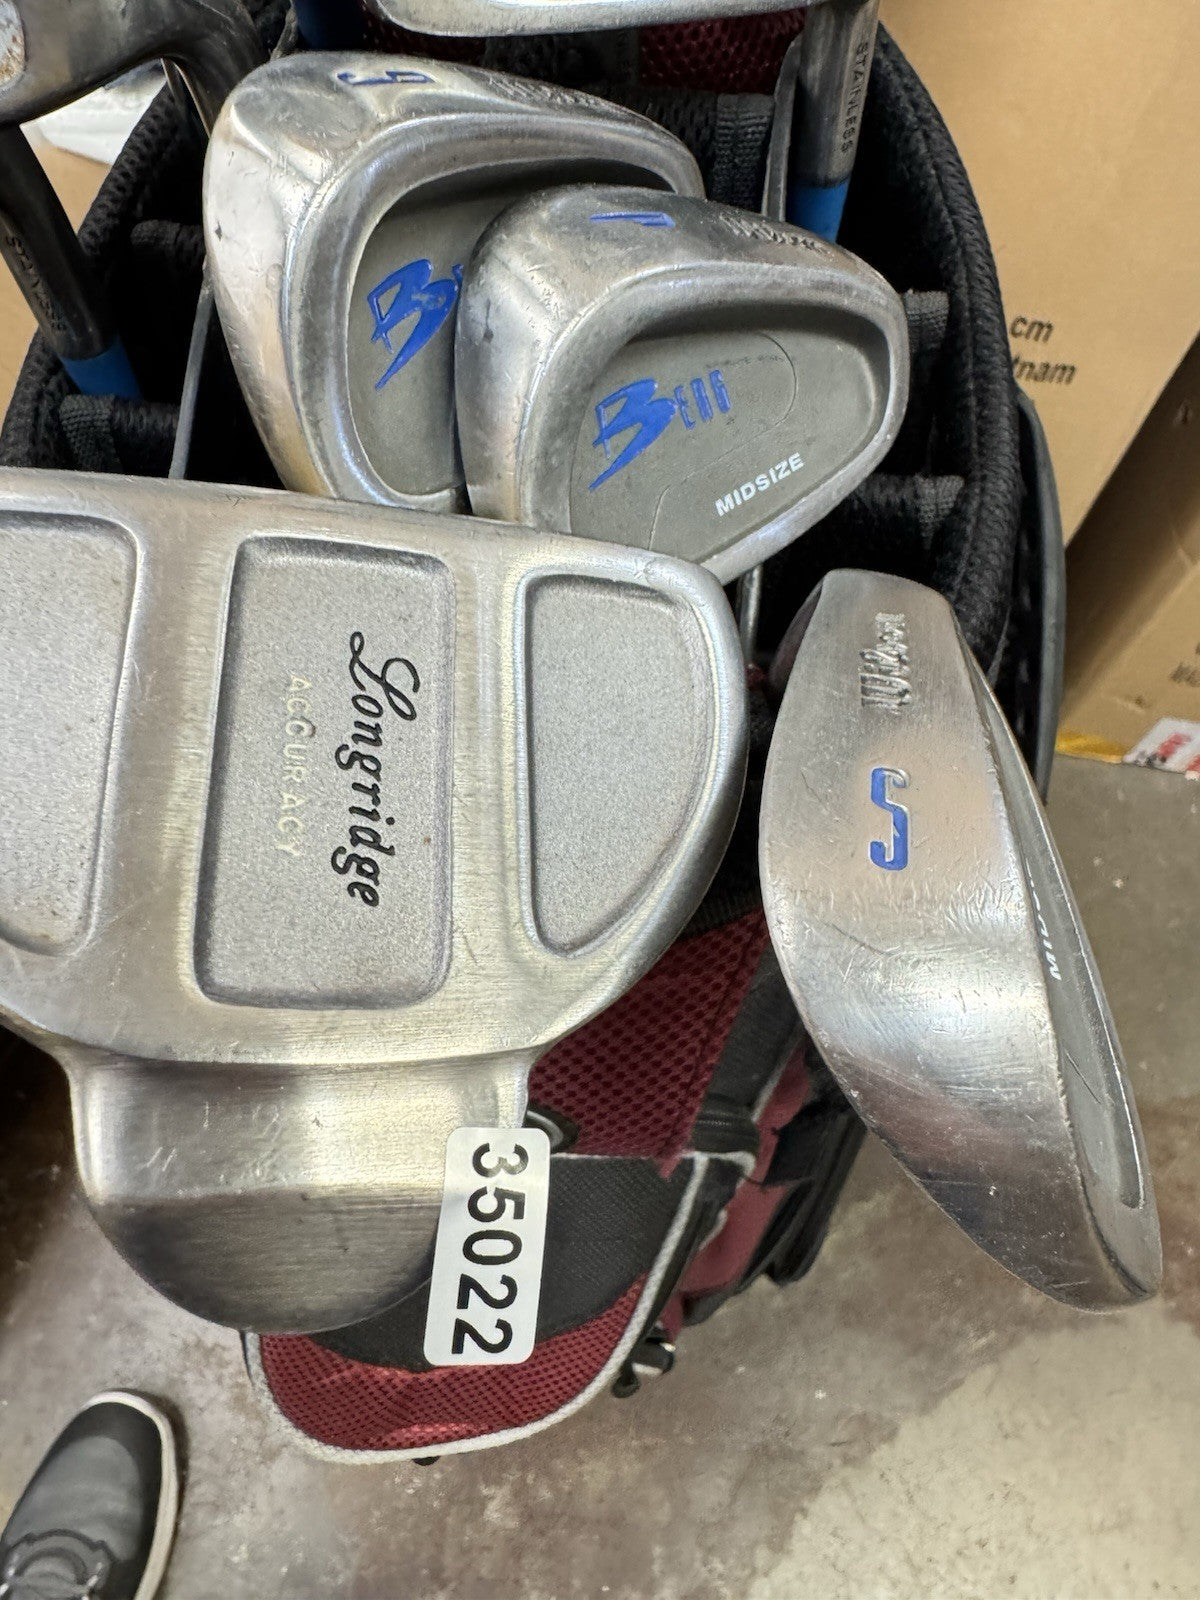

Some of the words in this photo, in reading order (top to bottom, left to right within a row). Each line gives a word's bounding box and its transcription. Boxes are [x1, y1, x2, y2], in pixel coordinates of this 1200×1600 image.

[1009, 315, 1054, 343] cm
[1013, 356, 1077, 385] nam
[714, 451, 805, 518] MIDSIZE
[277, 672, 313, 858] ACCURACY
[330, 630, 421, 908] Longridge
[868, 766, 911, 871] S
[451, 1142, 529, 1355] 35022
